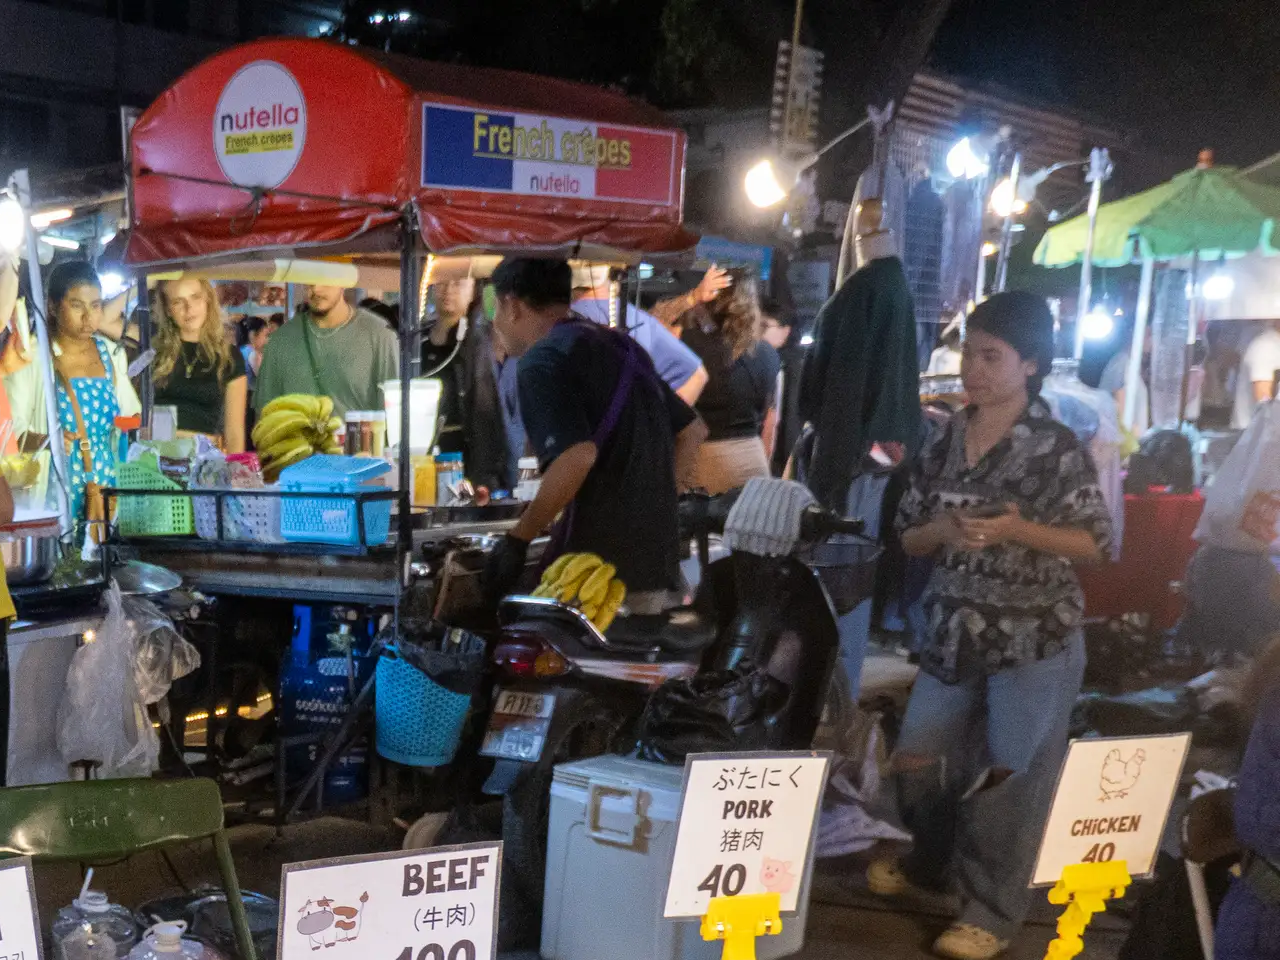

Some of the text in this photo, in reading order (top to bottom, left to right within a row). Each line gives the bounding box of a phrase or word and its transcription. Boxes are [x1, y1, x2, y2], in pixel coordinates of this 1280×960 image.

[221, 104, 299, 132] nutella
[225, 133, 258, 149] French
[473, 113, 631, 166] French crêpes
[529, 173, 581, 194] nutella
[712, 765, 803, 791] ぶたにく
[722, 800, 774, 820] PORK
[720, 828, 763, 852] 猪肉
[1081, 842, 1116, 863] 40
[401, 855, 490, 897] BEEF
[697, 863, 747, 899] 40
[414, 902, 476, 932] (牛肉)
